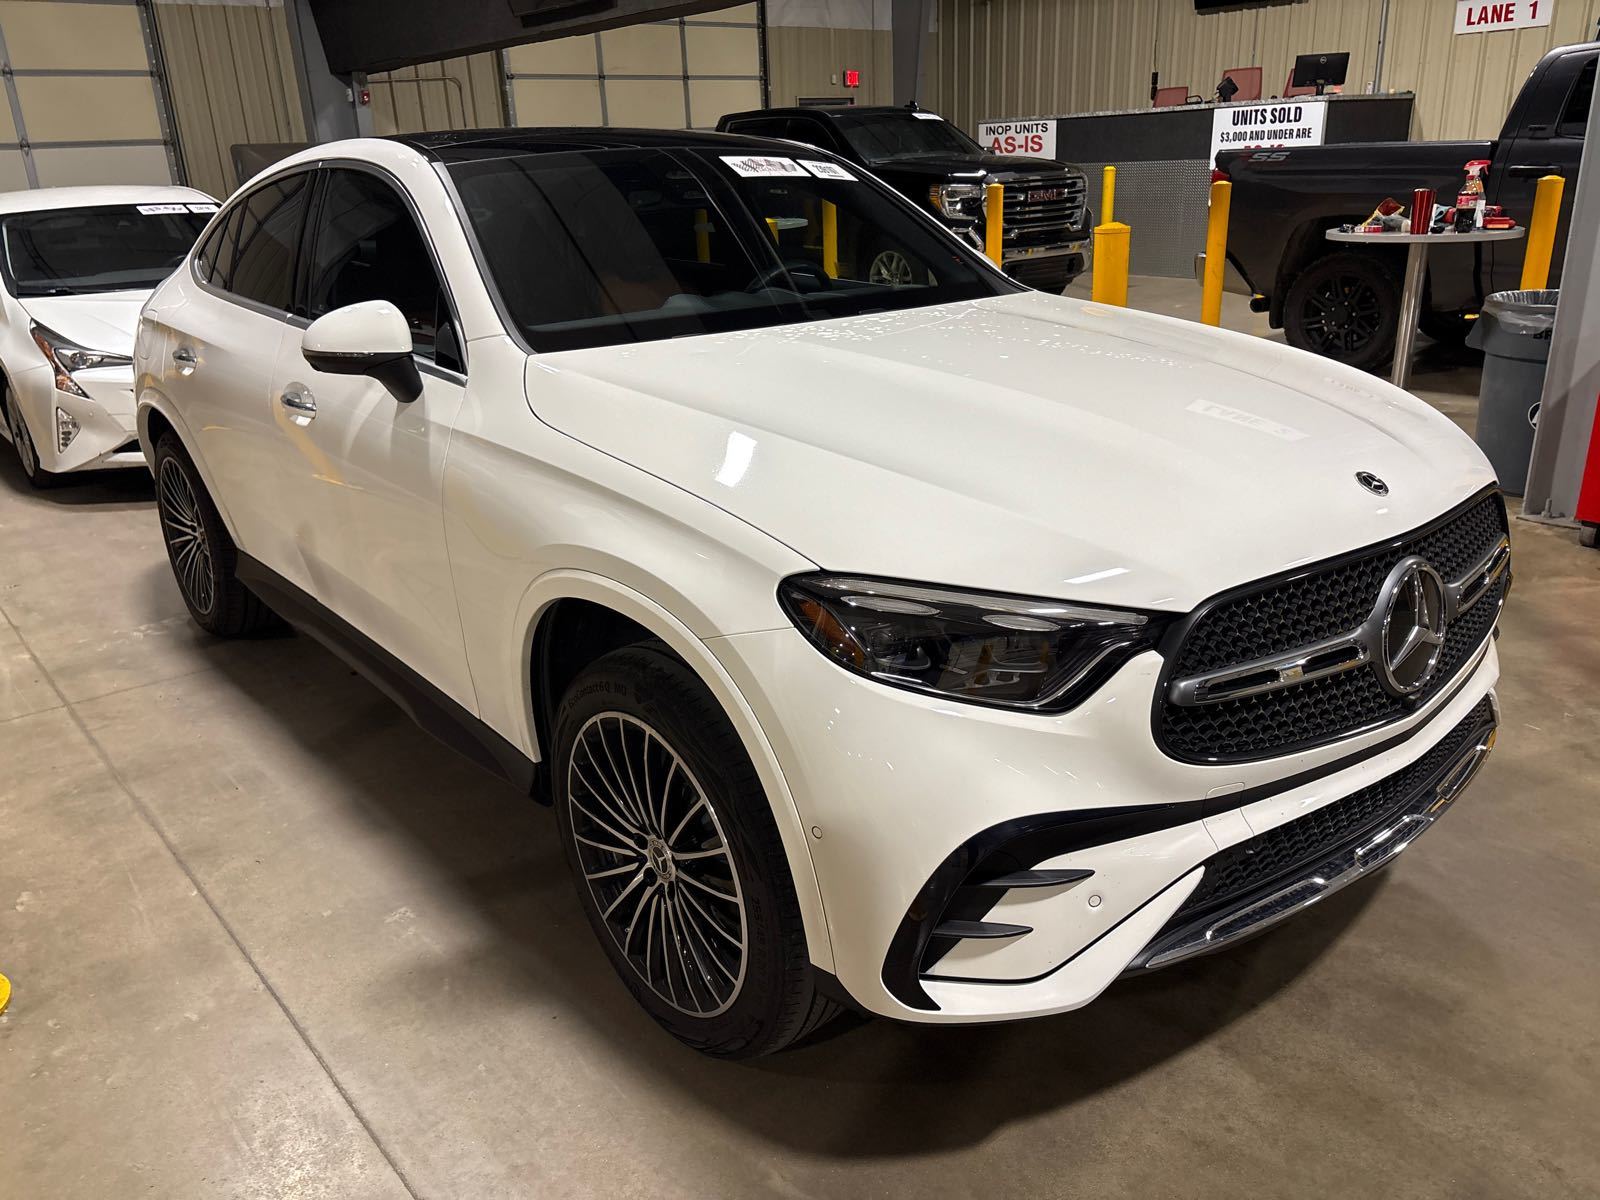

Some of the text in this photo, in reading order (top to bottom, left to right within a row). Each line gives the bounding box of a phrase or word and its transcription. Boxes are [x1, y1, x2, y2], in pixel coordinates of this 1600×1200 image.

[1466, 0, 1538, 26] LANE 1
[1232, 107, 1302, 126] UNITS SOLD
[985, 123, 1048, 136] INOP UNITS
[1220, 127, 1312, 143] $3,000 AND UNDER ARE
[991, 134, 1043, 154] AS-IS
